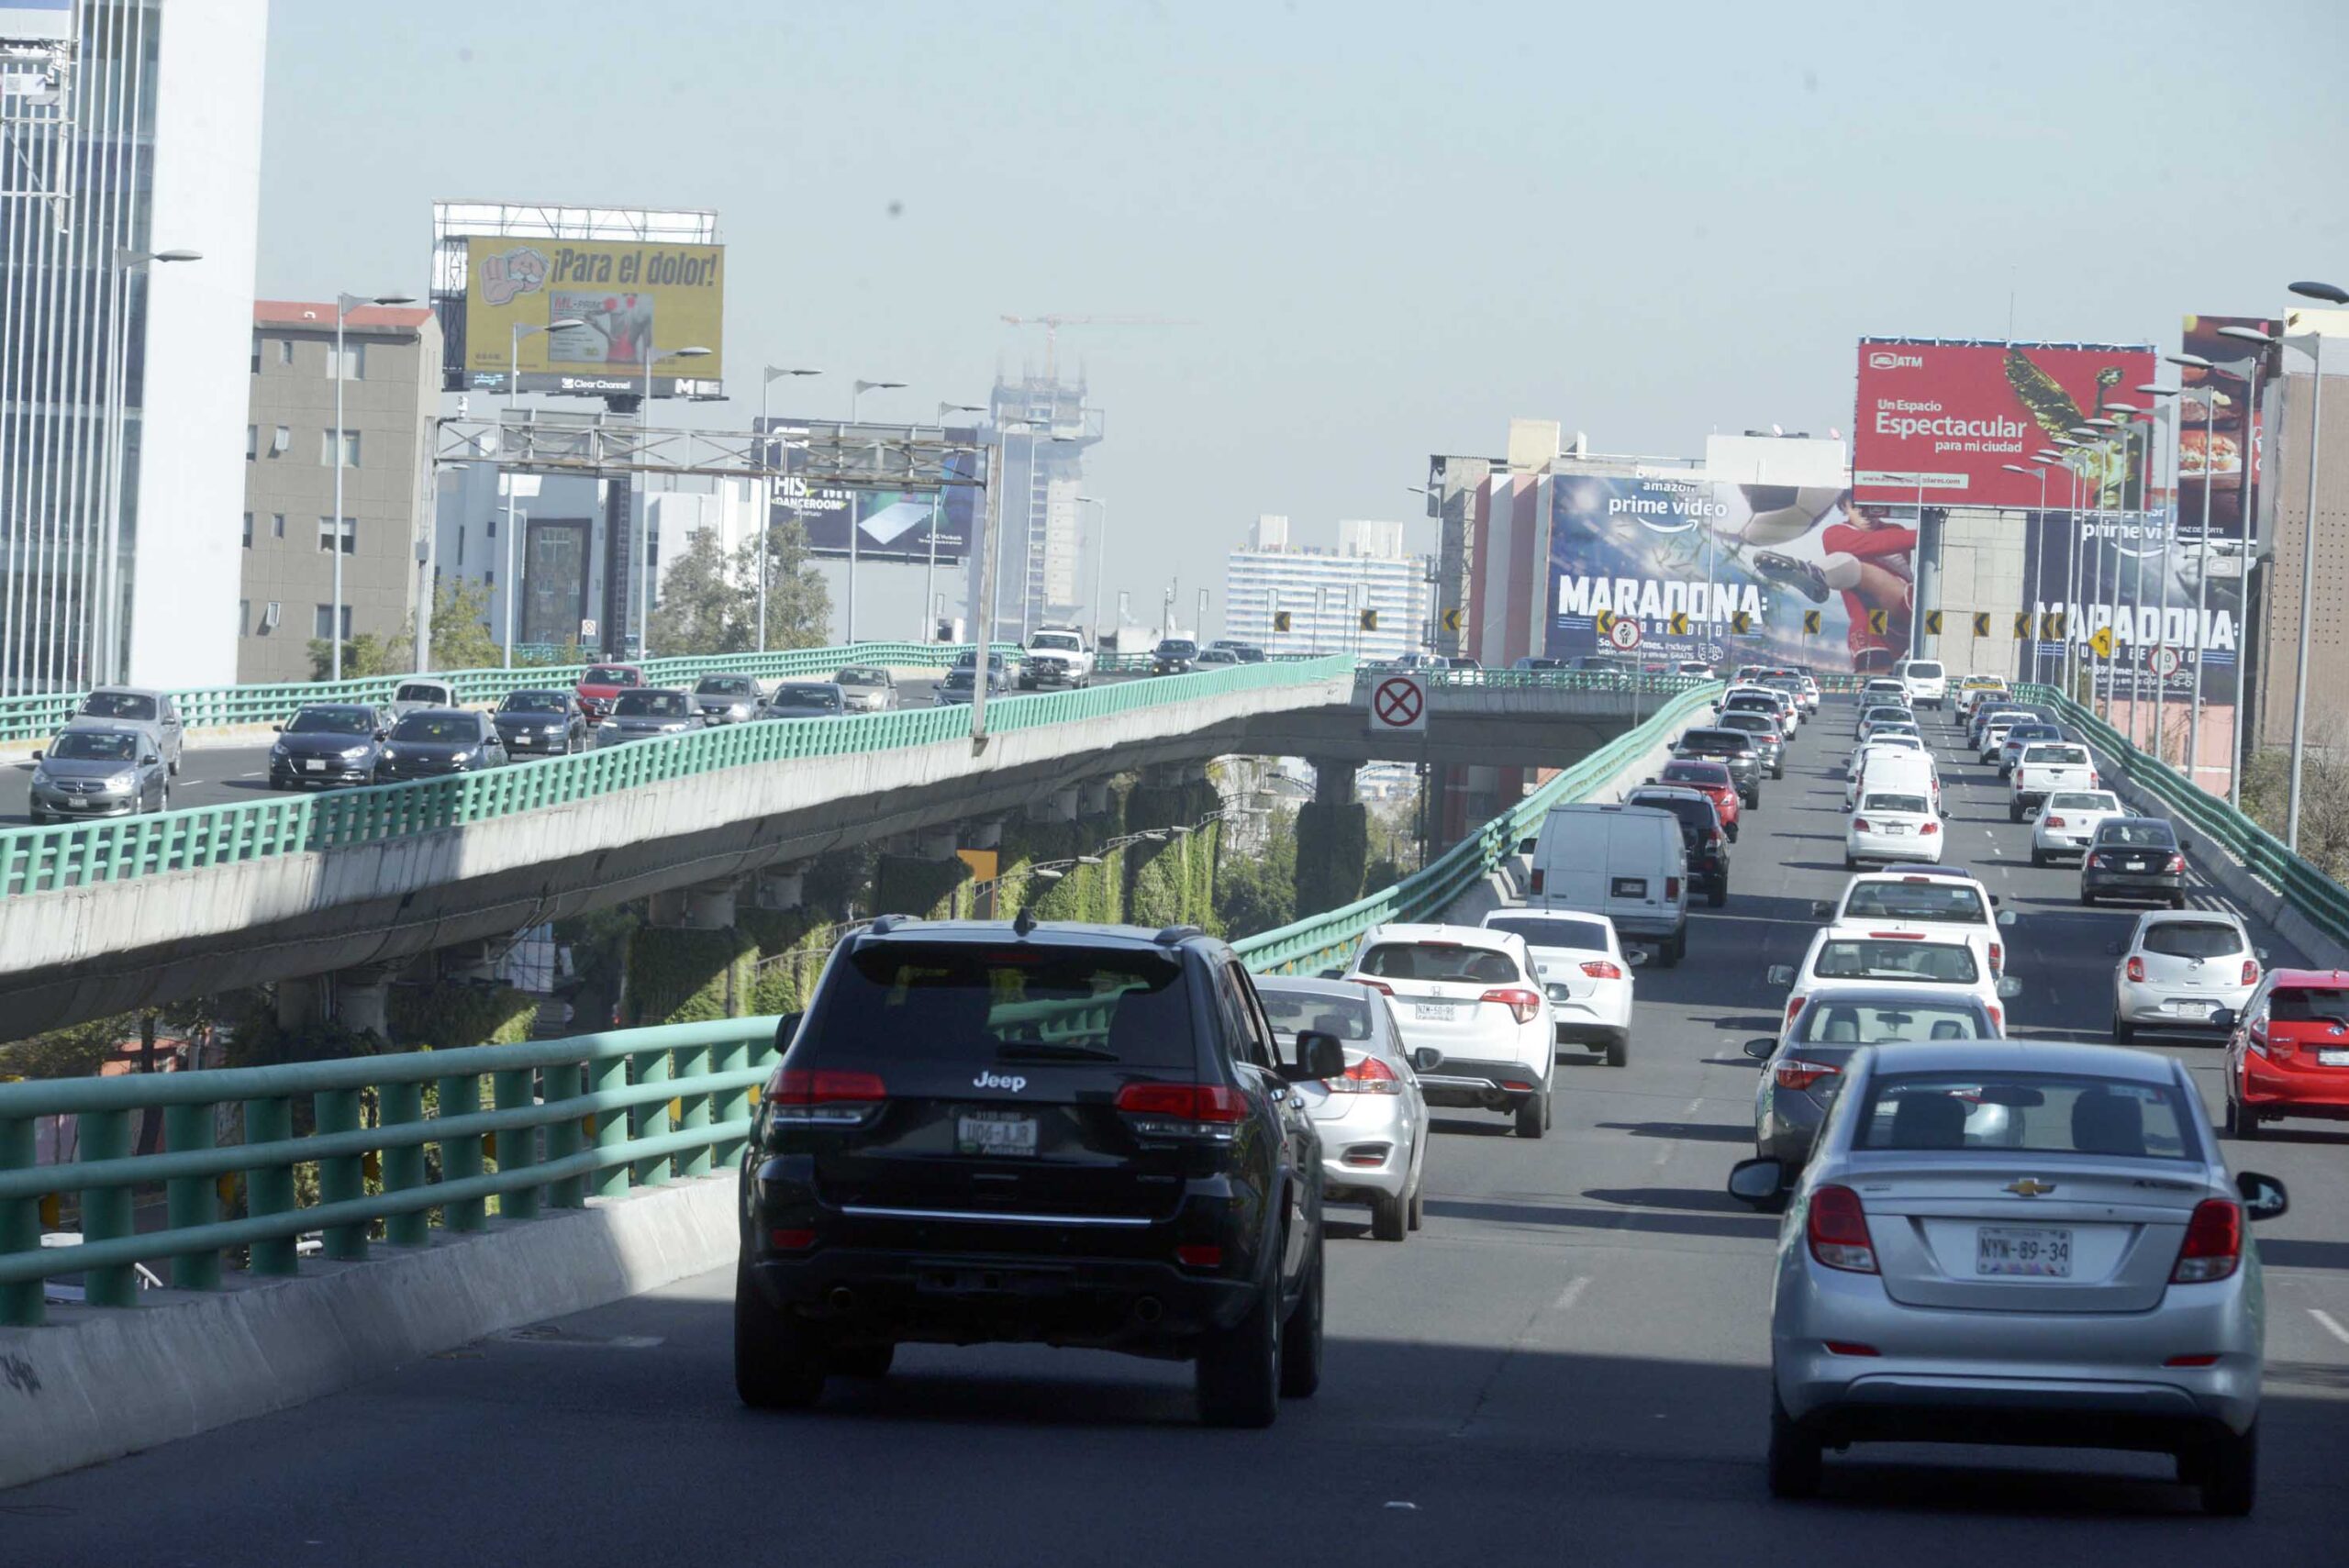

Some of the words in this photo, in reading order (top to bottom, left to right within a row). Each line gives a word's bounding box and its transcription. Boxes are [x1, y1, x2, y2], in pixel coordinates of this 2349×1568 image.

[552, 248, 613, 284] ¡Para
[618, 250, 642, 284] el
[647, 250, 718, 287] dolor!
[1897, 356, 1922, 368] ATM
[573, 379, 596, 389] Clear
[596, 380, 631, 390] Channel
[1877, 399, 1895, 410] Un
[1897, 400, 1943, 413] Espacio
[1876, 412, 2028, 440] Espectacular
[1935, 441, 1962, 453] para
[1965, 440, 1979, 451] mi
[1982, 441, 2022, 453] ciudad
[1609, 495, 1668, 516] prime
[1672, 497, 1728, 517] video
[973, 1071, 1027, 1093] Jeep
